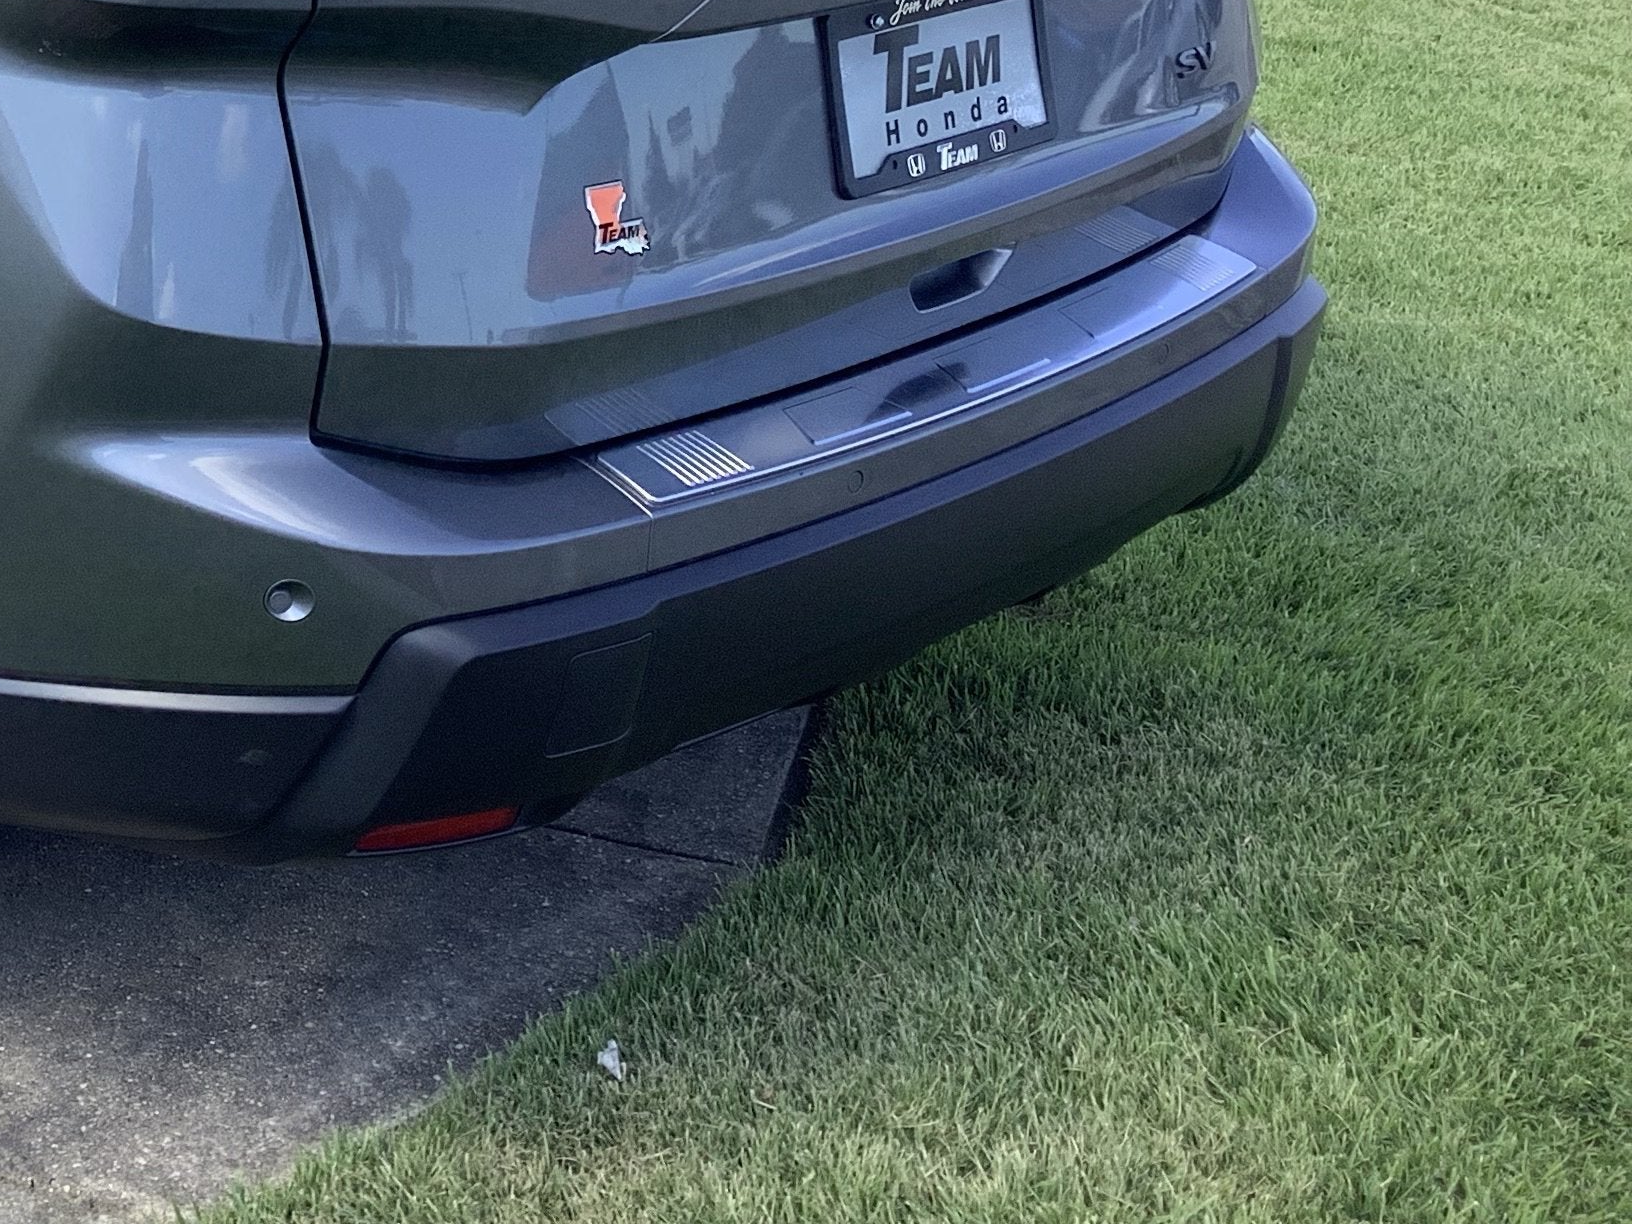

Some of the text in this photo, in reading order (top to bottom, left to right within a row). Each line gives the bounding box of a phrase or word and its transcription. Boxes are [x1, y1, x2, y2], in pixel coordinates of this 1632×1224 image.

[873, 24, 1001, 114] TEAM
[1175, 40, 1216, 79] SV
[885, 95, 1008, 146] Honda
[937, 142, 979, 171] TEAM
[599, 222, 640, 245] TEAM
